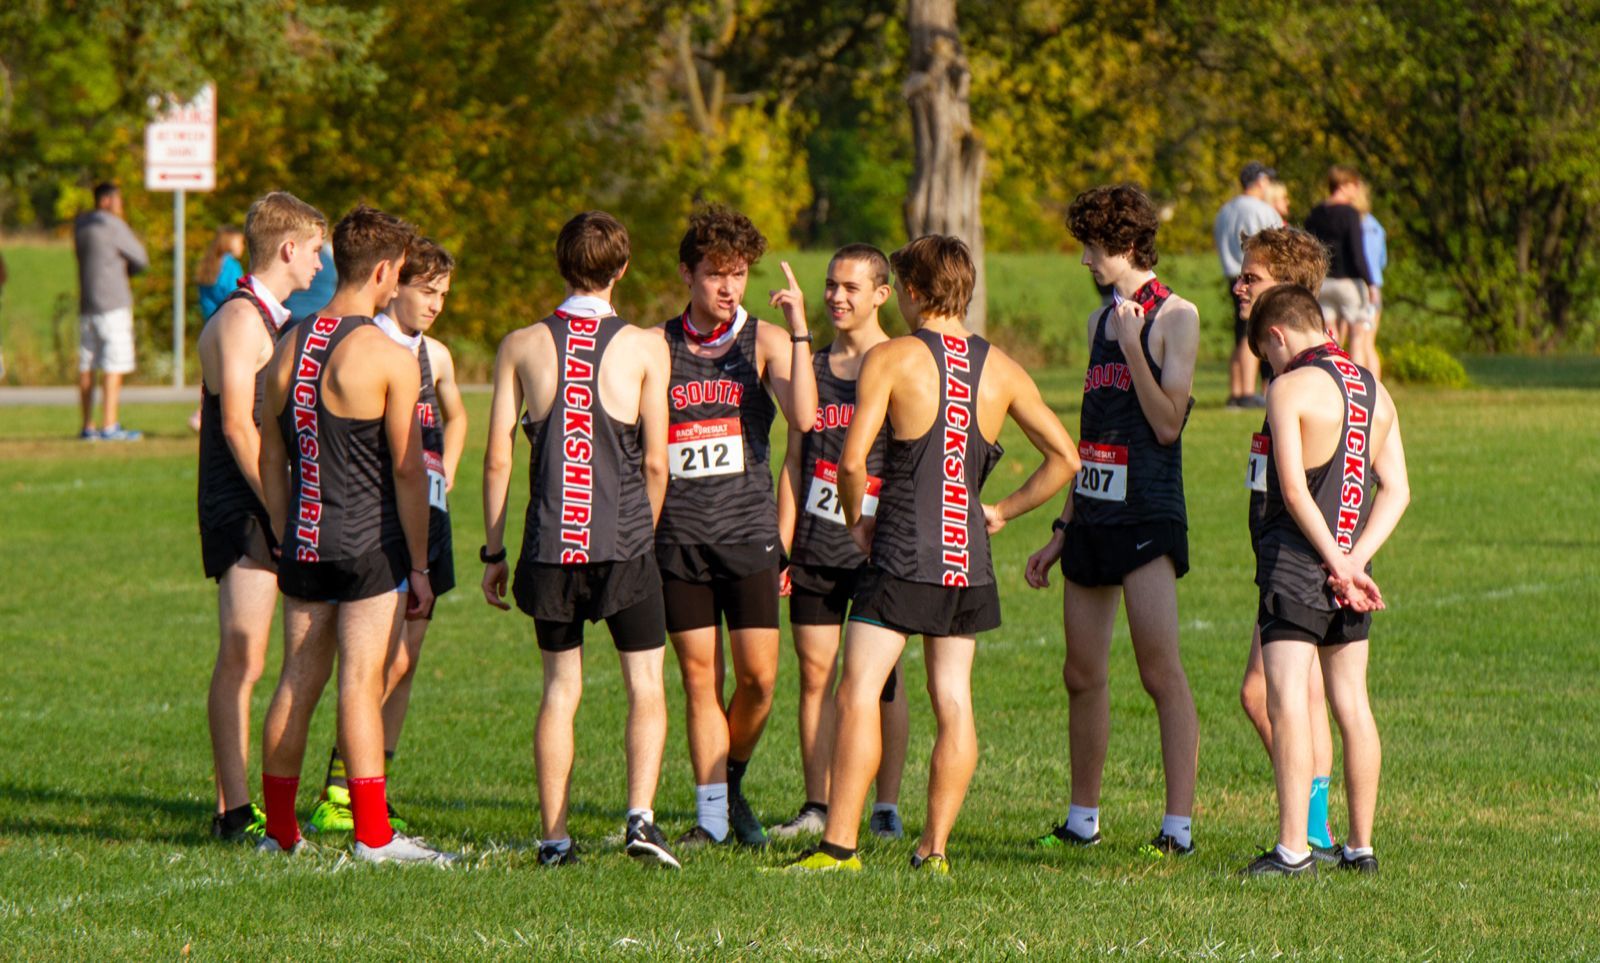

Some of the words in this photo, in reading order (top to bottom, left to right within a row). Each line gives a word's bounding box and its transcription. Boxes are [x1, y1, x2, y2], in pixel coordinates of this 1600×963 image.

[1084, 362, 1132, 392] SOUTH
[671, 379, 744, 410] SOUTH
[814, 403, 855, 432] SOU
[681, 443, 730, 471] 212
[1081, 465, 1114, 493] 207
[817, 487, 843, 515] 21
